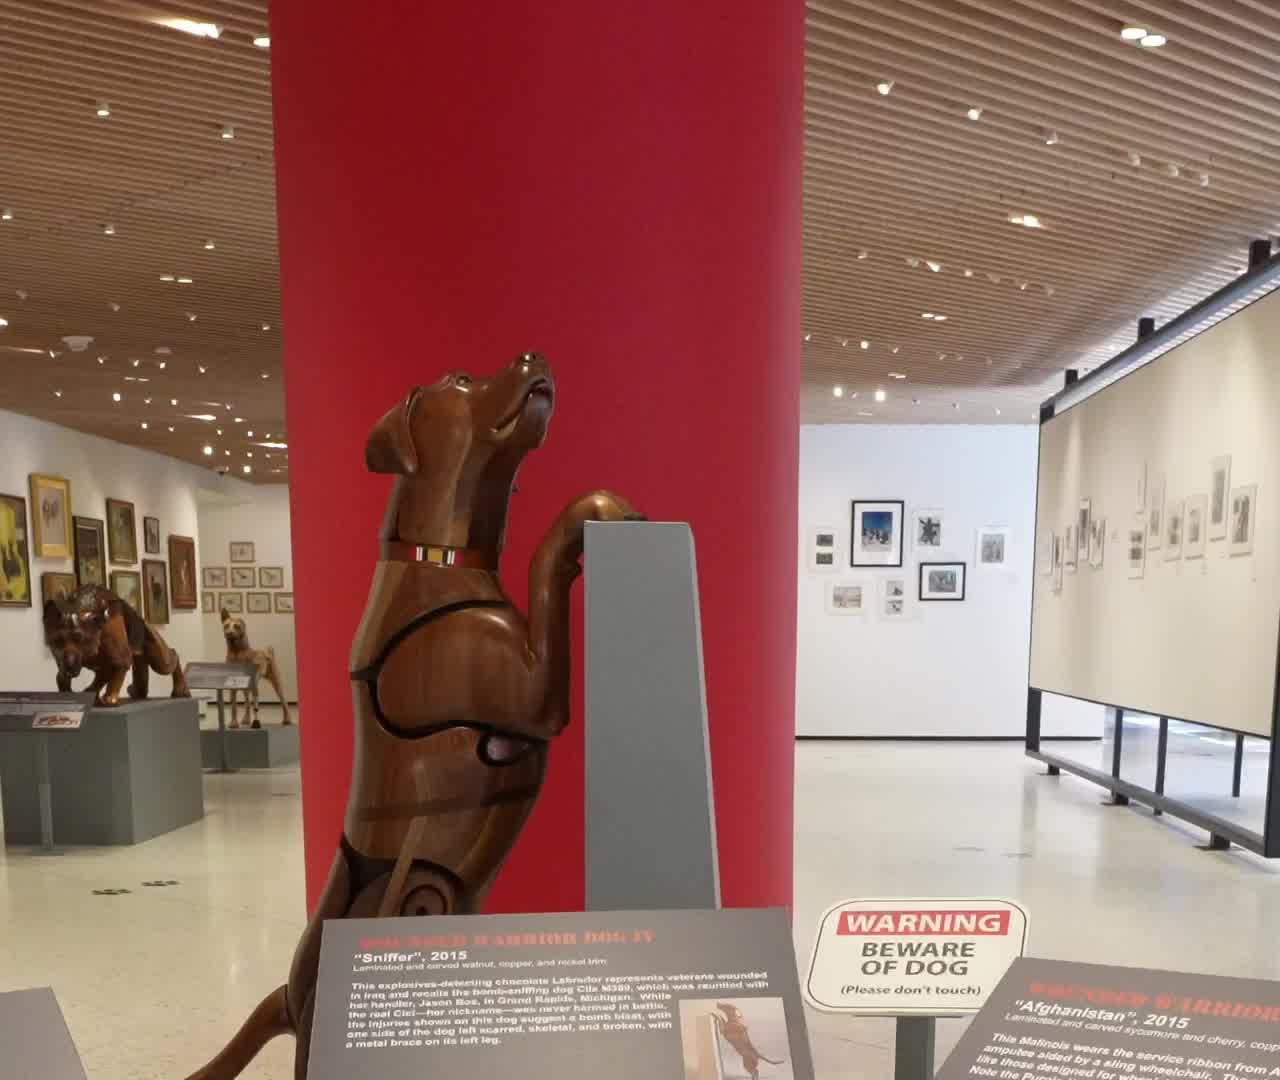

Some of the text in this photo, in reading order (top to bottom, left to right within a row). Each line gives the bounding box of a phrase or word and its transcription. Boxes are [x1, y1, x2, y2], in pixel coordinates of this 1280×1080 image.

[847, 914, 1001, 932] WARNING
[430, 950, 467, 961] 2015
[862, 942, 976, 958] BEWARE
[861, 960, 969, 976] OF DOG
[840, 984, 982, 996] (Please don't touch)
[1142, 1013, 1191, 1029] 2015
